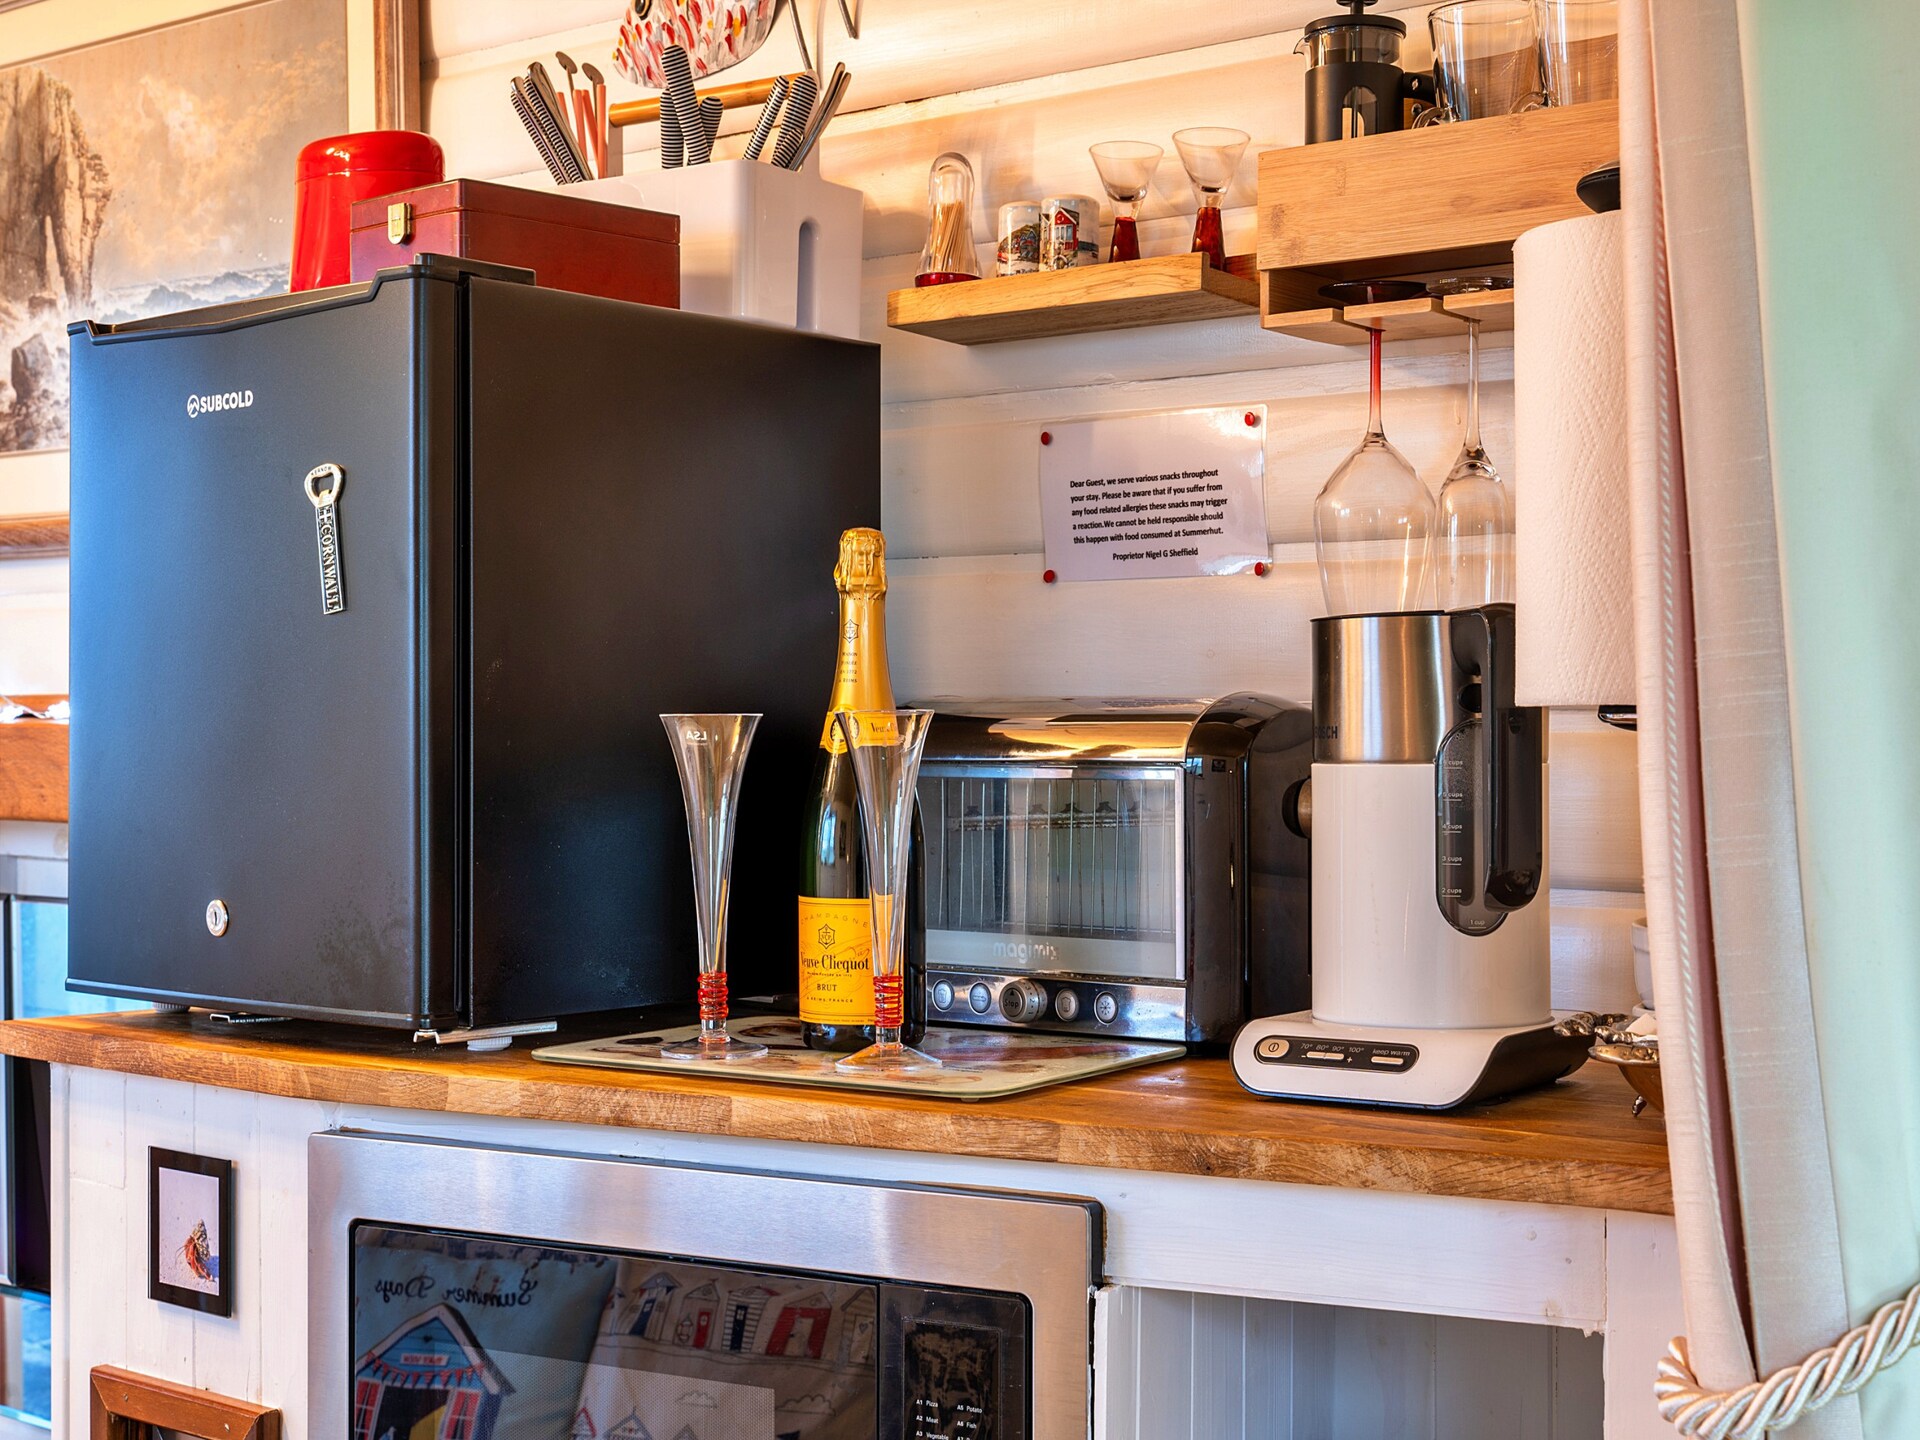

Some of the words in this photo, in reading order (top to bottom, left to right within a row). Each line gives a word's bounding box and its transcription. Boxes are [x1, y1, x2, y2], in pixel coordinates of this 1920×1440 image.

[200, 390, 254, 414] SUBCOLD
[1070, 480, 1084, 488] Dear
[1136, 474, 1158, 482] various
[1160, 472, 1180, 480] snacks
[1182, 469, 1218, 479] throughout
[1070, 495, 1084, 504] your
[1086, 494, 1100, 502] stay.
[1102, 492, 1122, 500] Please
[1152, 488, 1166, 496] that
[1167, 486, 1172, 494] if
[1173, 488, 1186, 496] you
[1186, 484, 1206, 493] suffer
[1206, 483, 1222, 491] from
[1084, 506, 1098, 515] food
[1099, 505, 1121, 514] related
[1122, 503, 1148, 512] allergies
[1168, 500, 1189, 508] snacks
[1206, 498, 1228, 507] trigger
[1116, 519, 1136, 527] cannot
[1147, 516, 1161, 524] held
[1162, 514, 1200, 524] responsible
[1200, 512, 1224, 521] should
[1086, 535, 1108, 544] happen
[1124, 532, 1139, 540] food
[1140, 530, 1172, 540] consumed
[1182, 527, 1224, 536] Summerhut.
[1112, 552, 1144, 561] Proprietor
[1146, 550, 1162, 560] Nigel
[1169, 548, 1198, 557] Sheffield
[321, 525, 340, 610] CORNWALL
[822, 954, 870, 973] Clicquot
[816, 984, 837, 992] BRUT
[1004, 998, 1018, 1008] Stop
[966, 1406, 982, 1414] Potato
[926, 1432, 949, 1440] Vegetable
